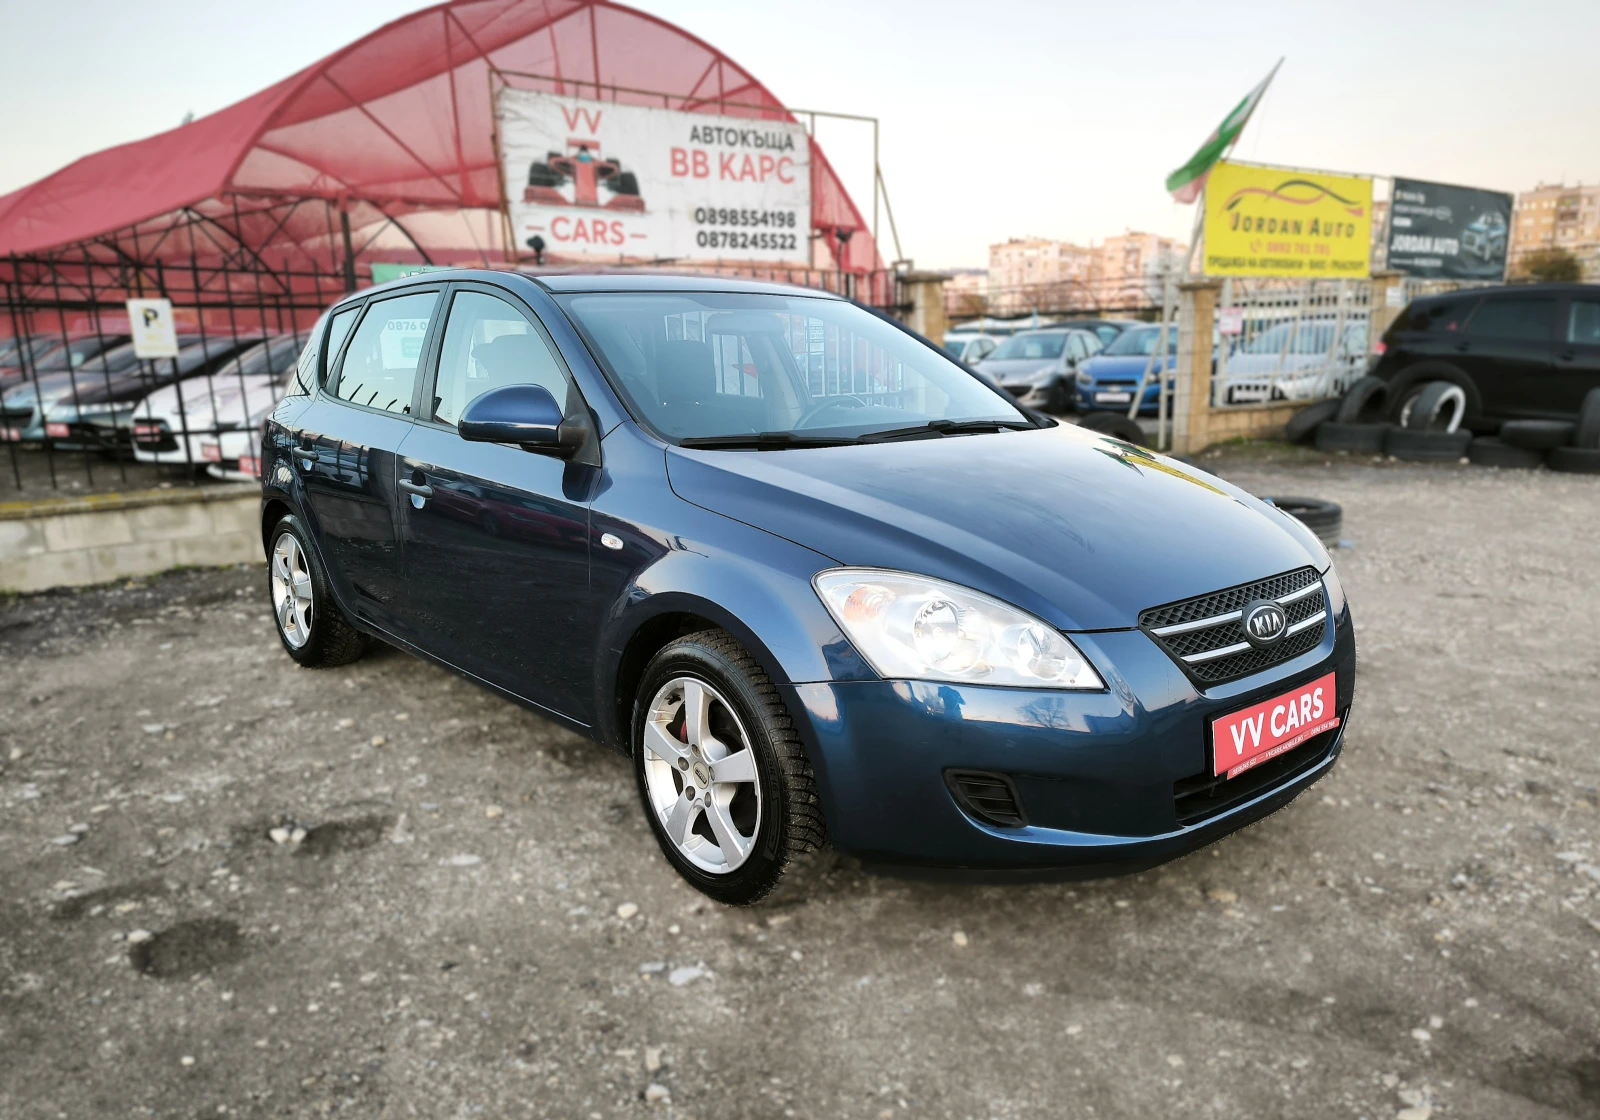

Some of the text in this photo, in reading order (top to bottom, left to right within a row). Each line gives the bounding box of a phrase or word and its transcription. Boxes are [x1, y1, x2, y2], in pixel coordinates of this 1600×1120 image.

[561, 106, 602, 135] VV
[689, 125, 795, 151] АВТОКЪЩА
[670, 147, 794, 184] ВВ КАРС
[695, 208, 796, 228] 0898554198
[550, 217, 625, 245] CARS
[697, 230, 797, 250] 0878245522
[1391, 233, 1459, 256] JORDAN AUTO
[388, 321, 416, 330] 0876
[1252, 612, 1282, 635] KIA
[1230, 687, 1324, 756] VV CARS
